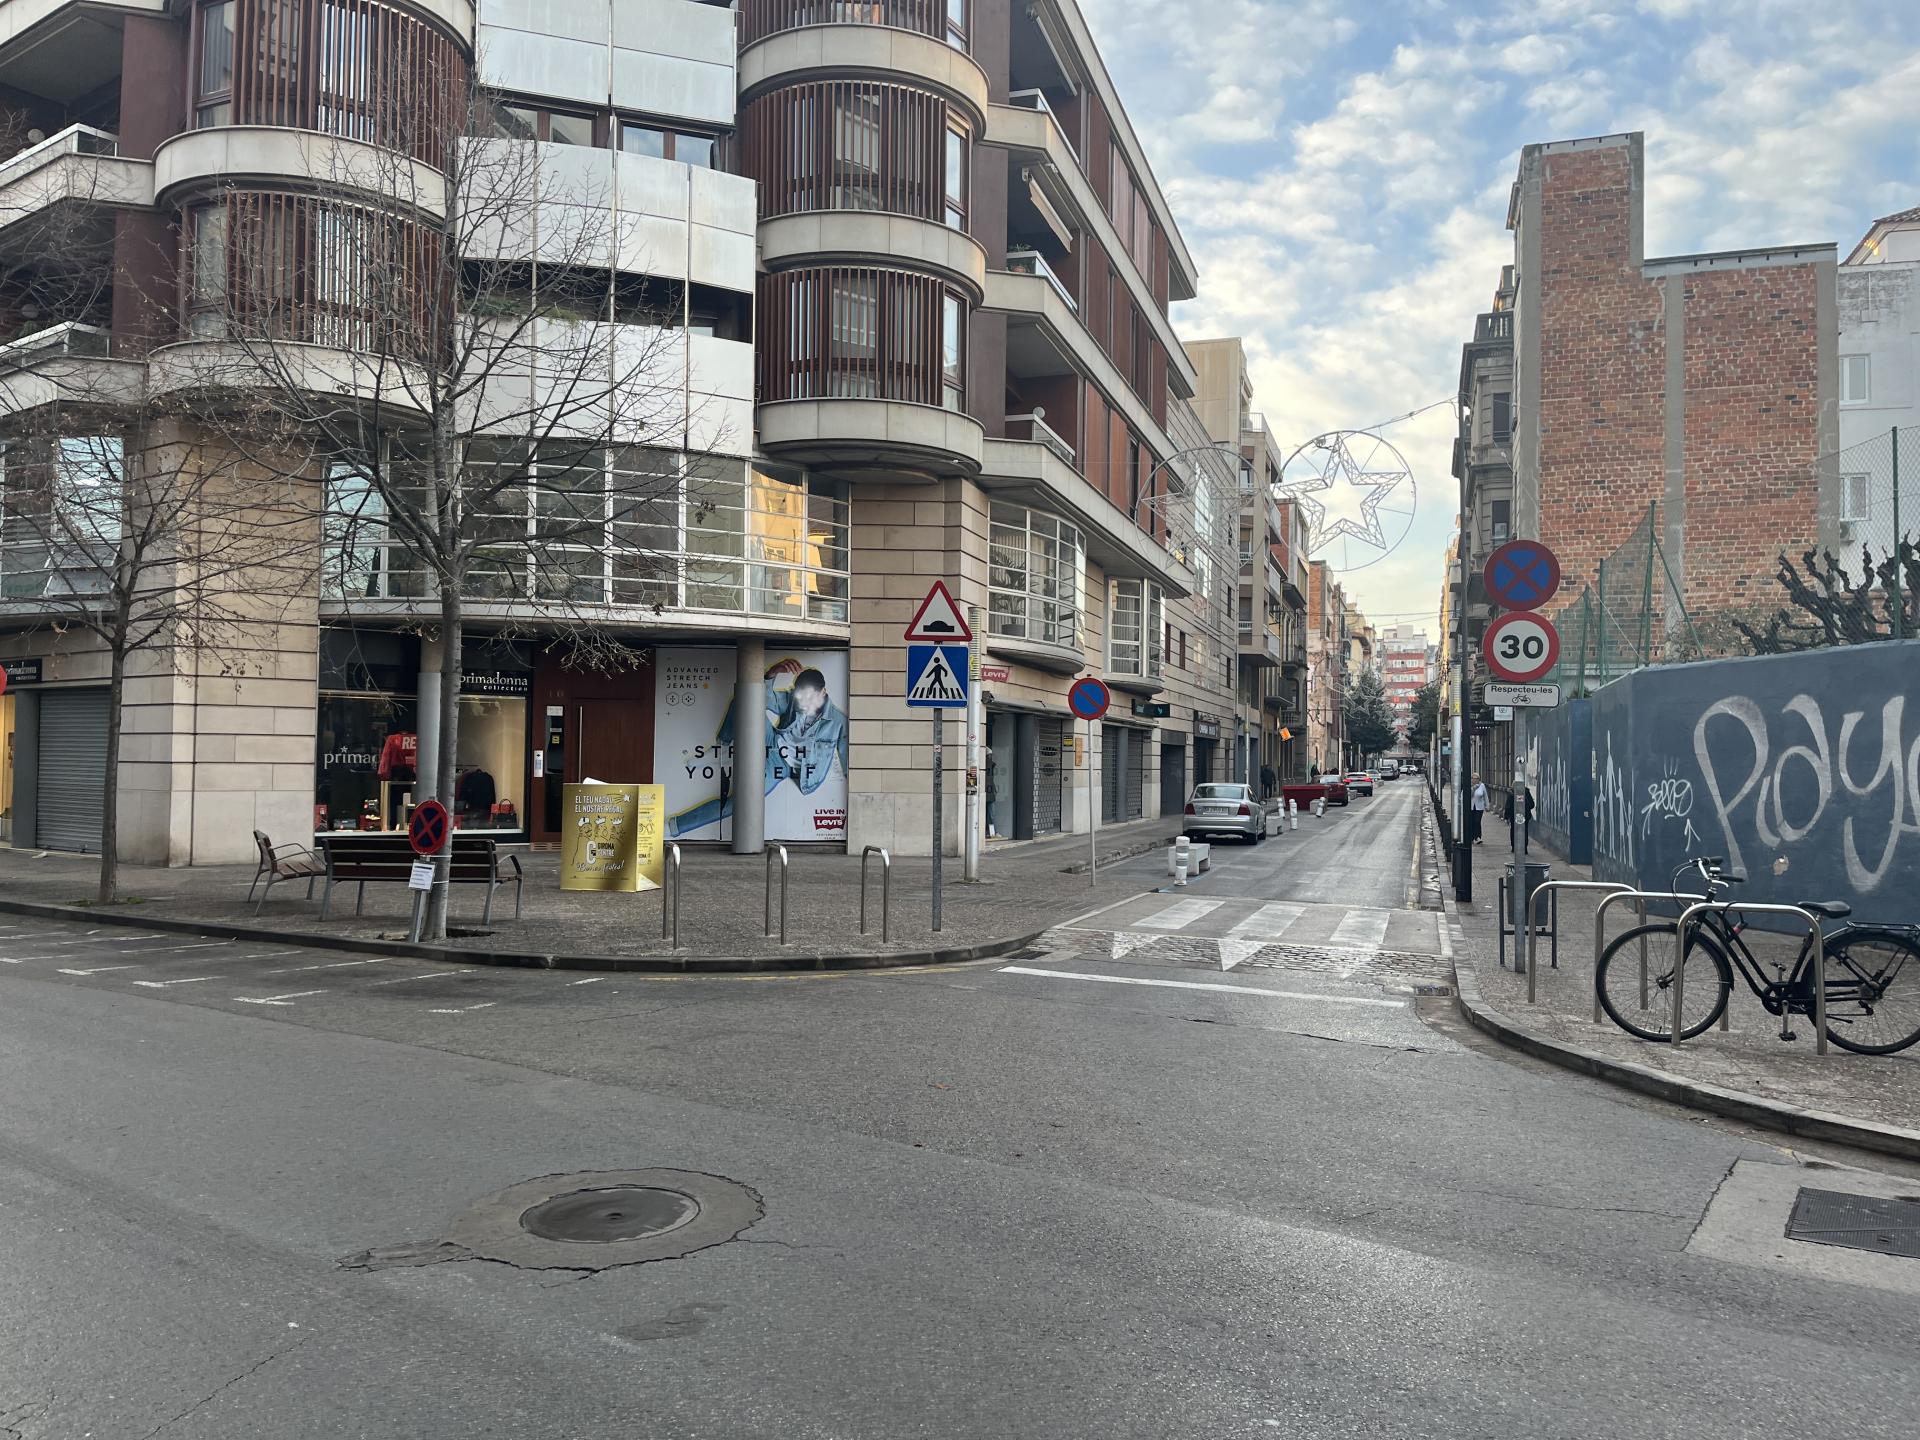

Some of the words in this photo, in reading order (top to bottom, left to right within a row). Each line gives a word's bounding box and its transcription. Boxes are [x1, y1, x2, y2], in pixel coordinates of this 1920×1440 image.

[1500, 635, 1544, 659] 30
[1490, 685, 1553, 695] Respecteu-les
[575, 796, 582, 804] EL
[583, 796, 594, 804] TEU
[575, 805, 582, 813] EL
